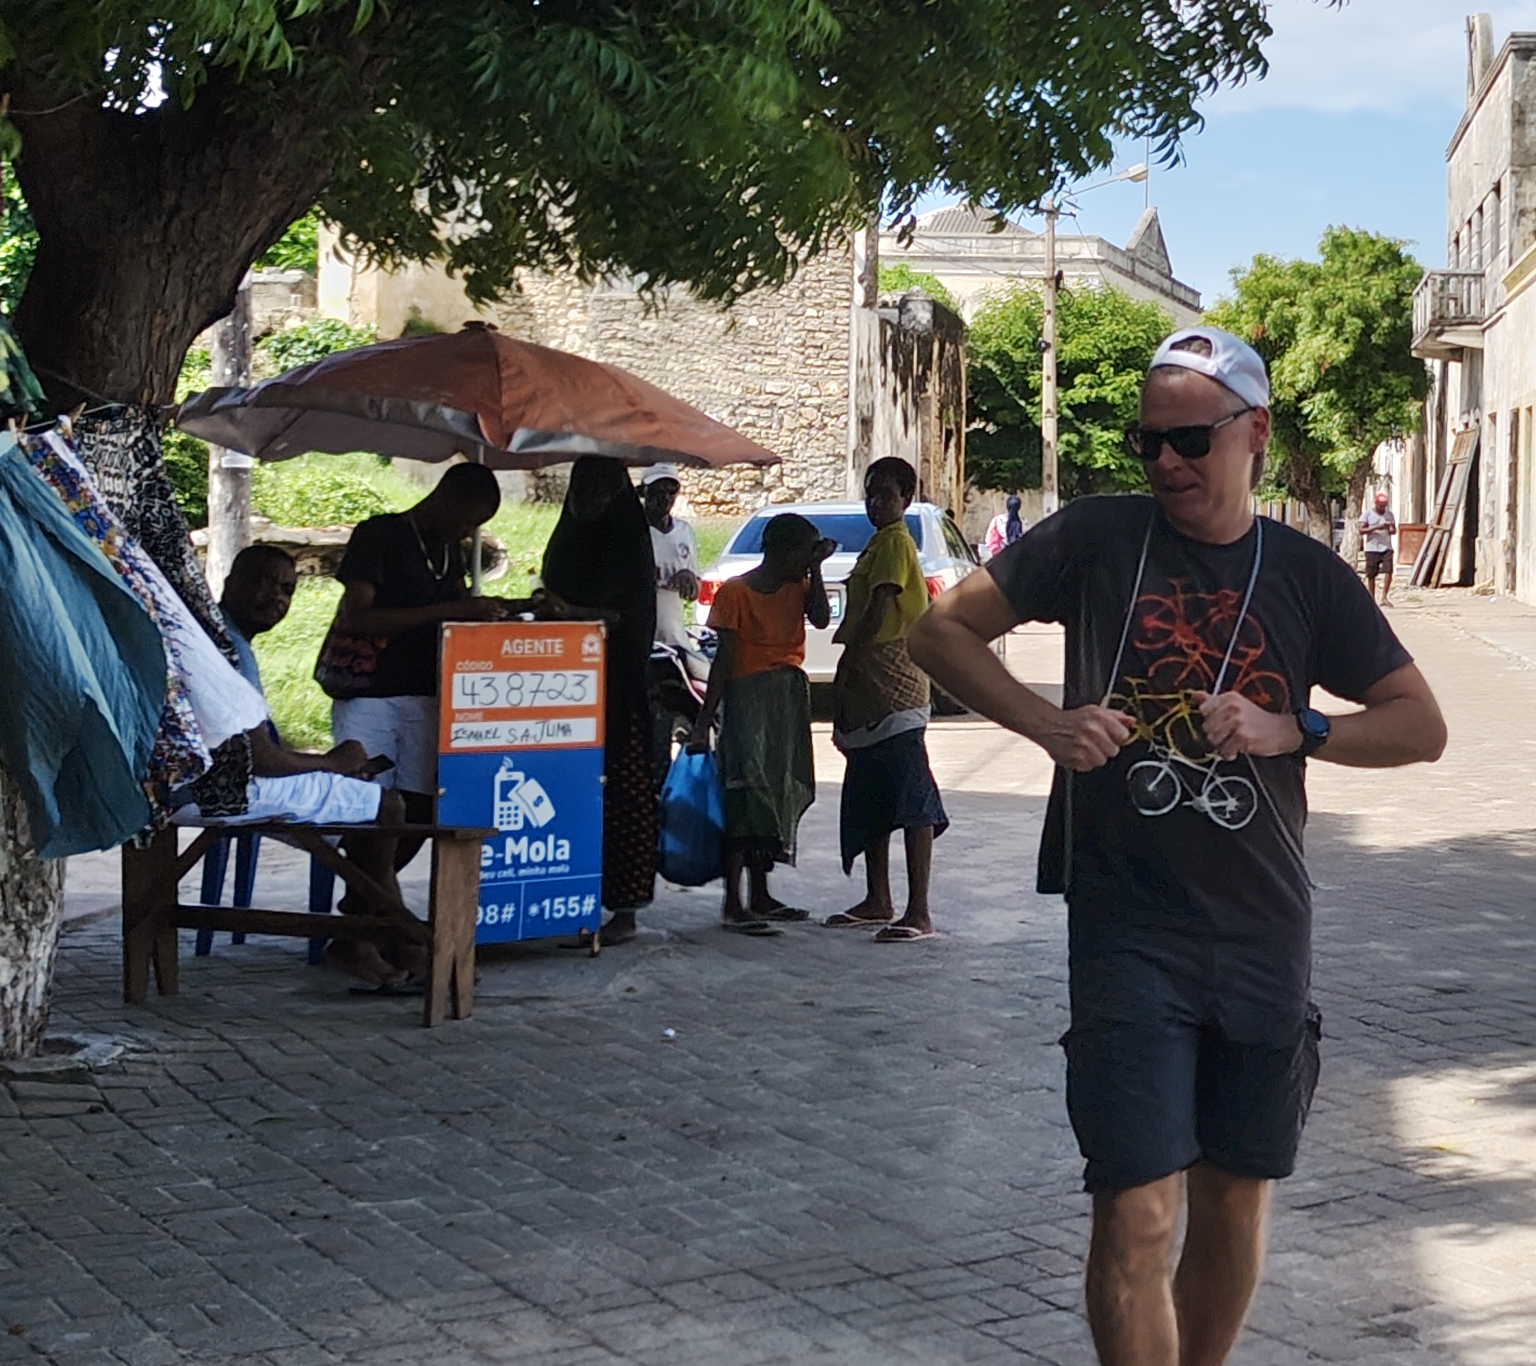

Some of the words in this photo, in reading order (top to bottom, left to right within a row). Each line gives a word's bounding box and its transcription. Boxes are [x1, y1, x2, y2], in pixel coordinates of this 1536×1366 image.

[501, 638, 565, 654] AGENTE
[461, 672, 590, 707] 438723
[480, 834, 570, 867] e-Mola
